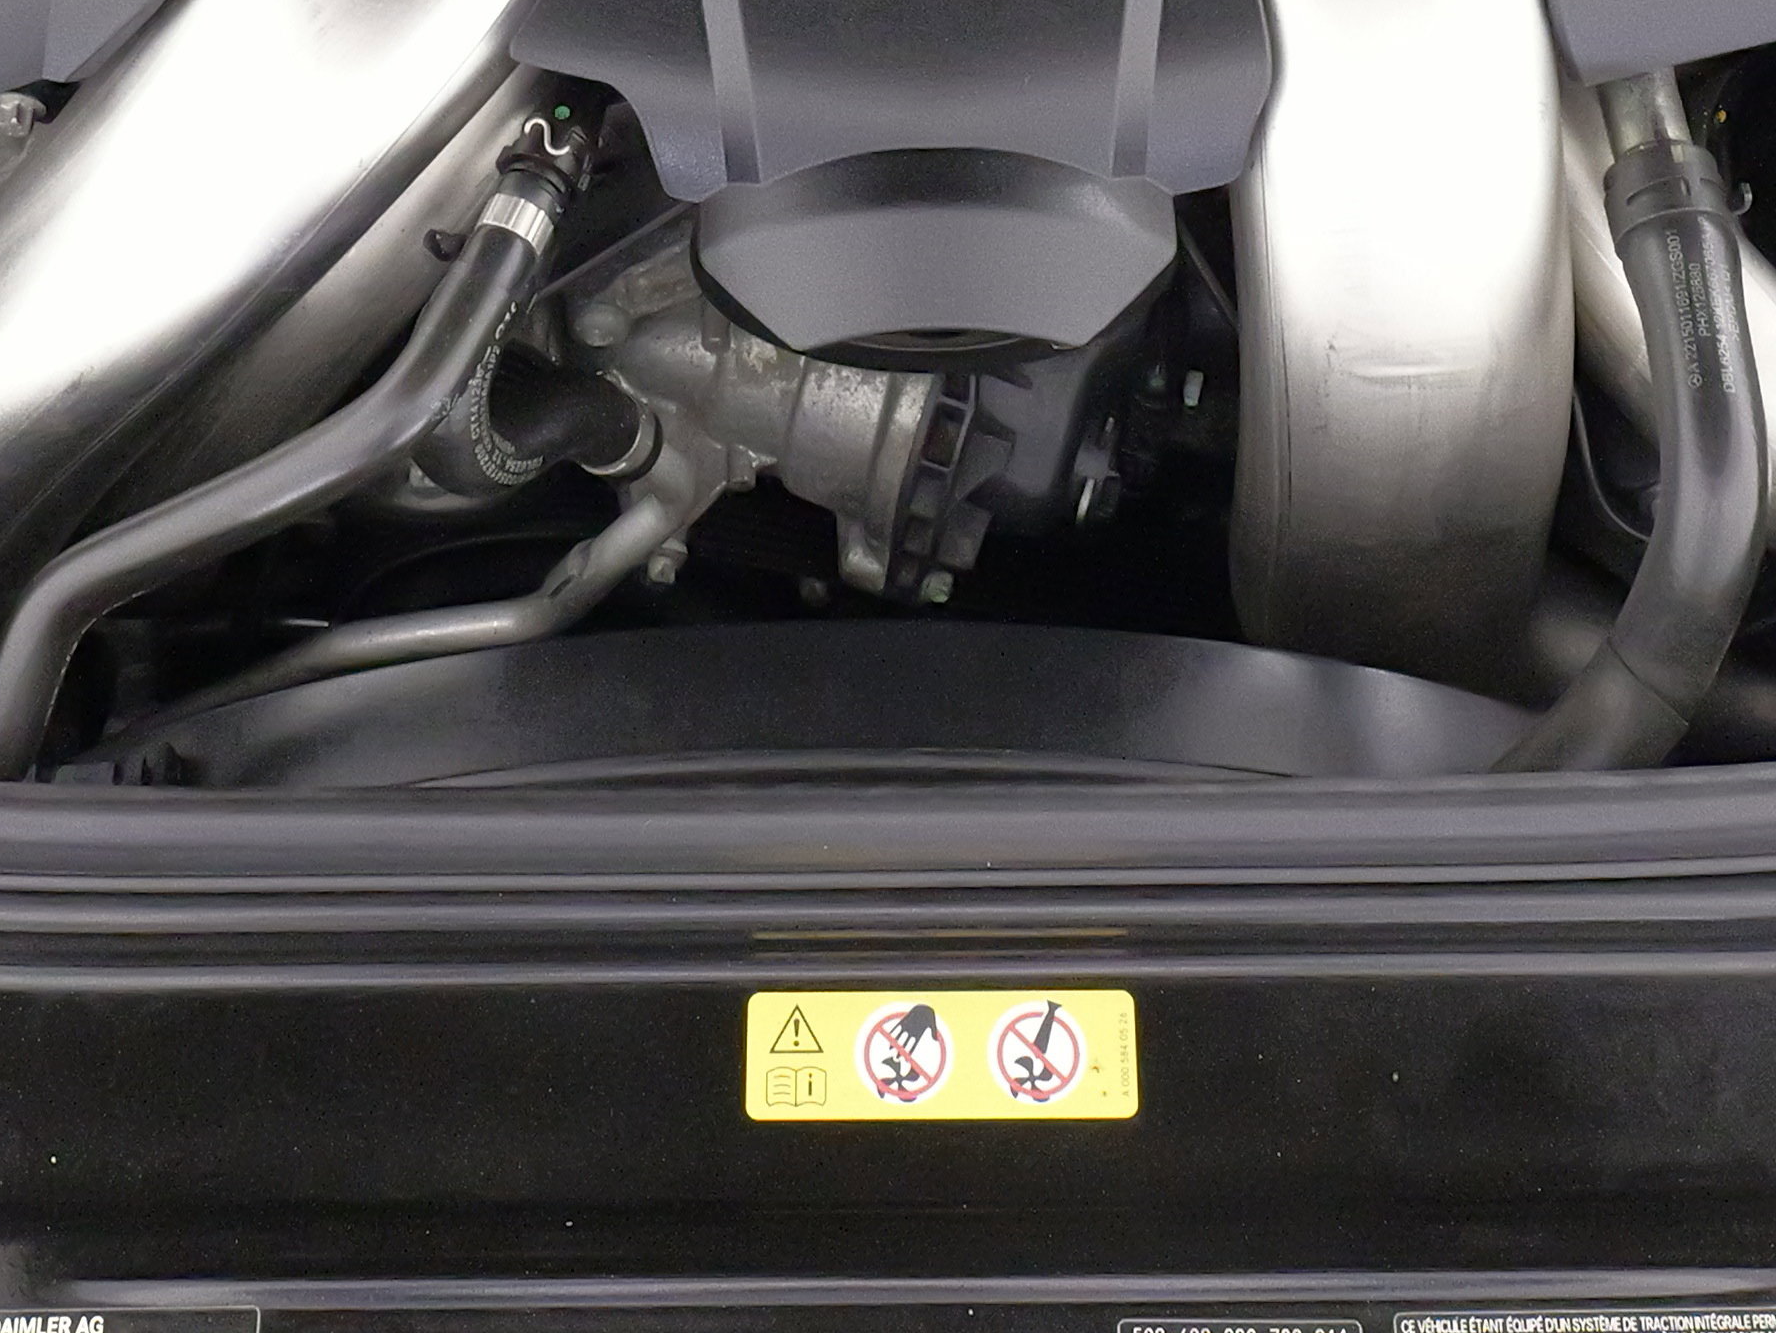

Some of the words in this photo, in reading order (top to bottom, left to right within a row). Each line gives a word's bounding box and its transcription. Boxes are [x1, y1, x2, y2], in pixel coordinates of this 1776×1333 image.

[74, 1315, 105, 1333] AG
[1401, 1318, 1416, 1333] CE
[1468, 1316, 1504, 1333] ÉTANT
[1624, 1316, 1639, 1332] DE
[1639, 1315, 1694, 1332] TRACTION
[1693, 1312, 1752, 1331] INTÉGRALE
